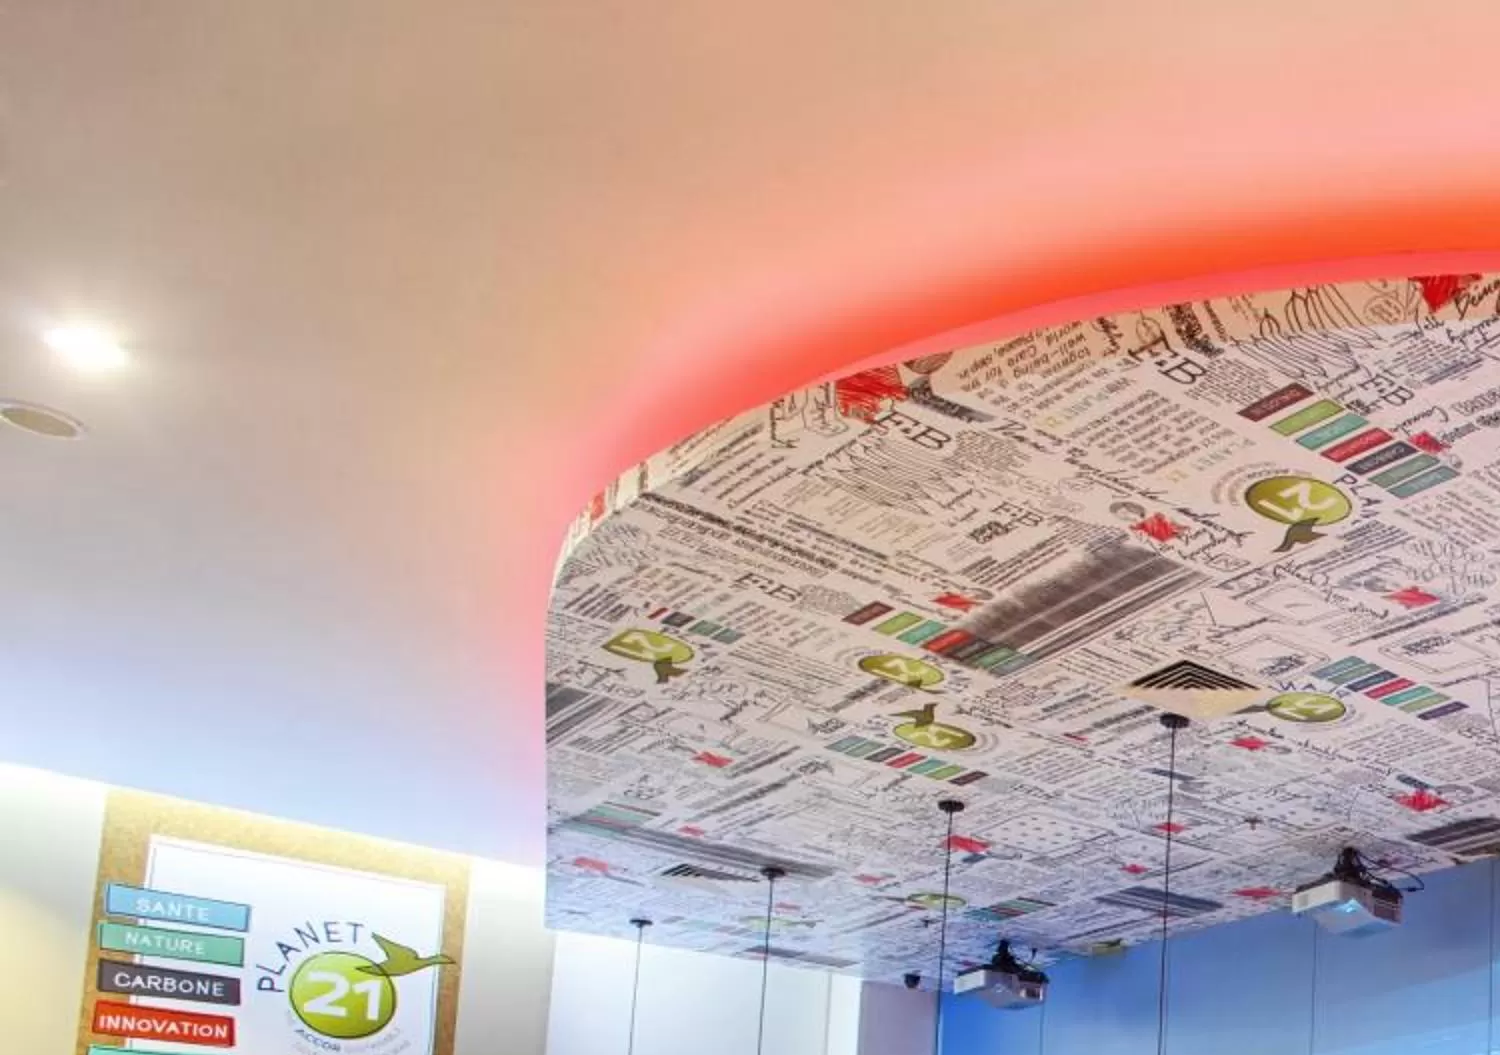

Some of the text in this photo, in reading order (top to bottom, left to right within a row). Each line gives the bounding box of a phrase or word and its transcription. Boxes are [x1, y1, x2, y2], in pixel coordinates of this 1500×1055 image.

[125, 931, 206, 955] NATURE
[256, 921, 364, 993] PLANET
[114, 972, 225, 997] CARBONE
[303, 970, 384, 1021] 21
[99, 1014, 228, 1038] INNOVATION
